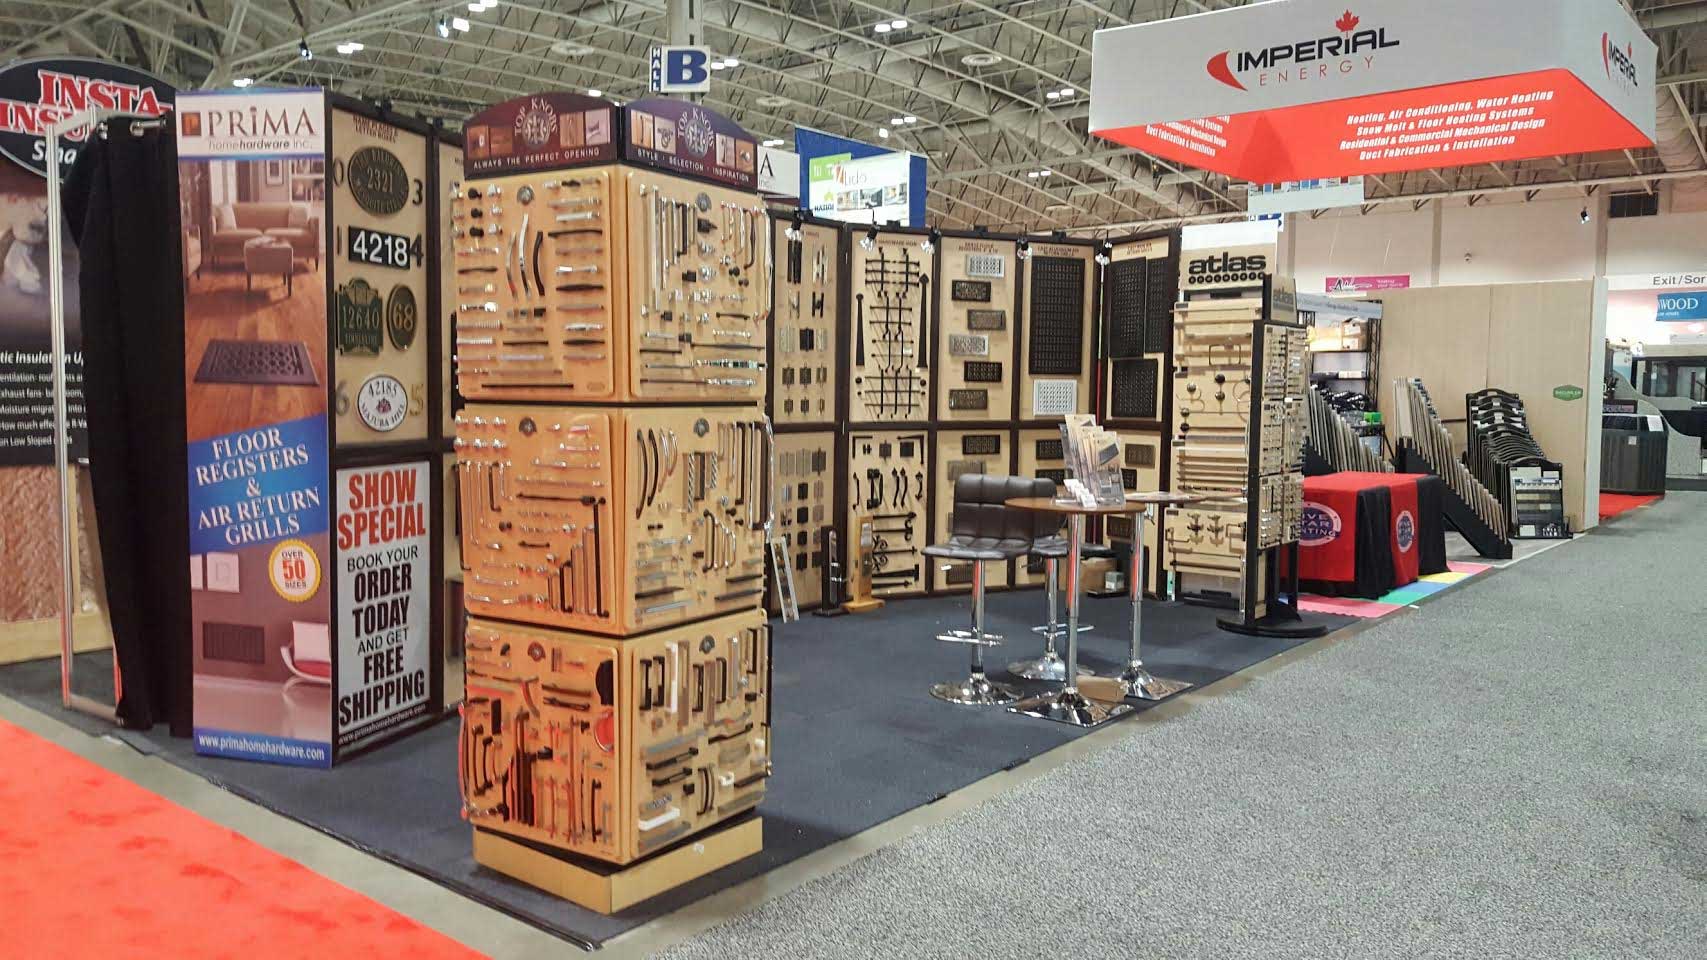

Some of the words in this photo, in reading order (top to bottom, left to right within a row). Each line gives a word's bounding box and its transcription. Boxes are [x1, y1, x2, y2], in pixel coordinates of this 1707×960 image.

[652, 47, 661, 92] HALL
[667, 50, 708, 84] B
[1260, 55, 1374, 87] ENERGY
[514, 106, 526, 137] TOP
[1347, 113, 1386, 125] Heating,
[1388, 109, 1403, 120] Air
[1405, 100, 1473, 119] Conditioning,
[1476, 96, 1508, 109] Water
[1511, 90, 1554, 104] Heating
[1356, 124, 1382, 137] Snow
[1384, 121, 1407, 133] Melt
[1408, 121, 1415, 130] &
[1417, 116, 1444, 129] Floor
[1446, 111, 1487, 126] Heating
[1488, 105, 1534, 121] Systems
[677, 111, 688, 139] TOP
[1339, 135, 1390, 151] Residential
[1390, 136, 1397, 145] &
[1398, 127, 1453, 144] Commercial
[1454, 121, 1510, 138] Mechanical
[1511, 117, 1546, 132] Design
[473, 158, 502, 170] ALWAYS
[507, 157, 520, 166] THE
[525, 152, 560, 165] PERFECT
[564, 147, 600, 160] OPENING
[1359, 148, 1382, 161] Duct
[1383, 141, 1441, 159] Fabrication
[1442, 142, 1450, 152] &
[1452, 134, 1516, 150] Installation
[637, 148, 658, 161] STYLE
[669, 155, 704, 171] SELECTION
[712, 167, 749, 183] INSPIRATION
[353, 230, 408, 267] 4218
[410, 233, 424, 267] 4
[1188, 252, 1266, 275] atlas
[393, 304, 414, 332] 68
[16, 350, 71, 364] Insulatn
[212, 427, 283, 460] FLOOR
[195, 443, 309, 486] REGISTERS
[245, 477, 262, 497] &
[348, 469, 417, 510] SHOW
[198, 504, 233, 530] AIR
[236, 486, 321, 521] RETURN
[225, 513, 300, 545] GRILLS
[337, 502, 426, 551] SPECIAL
[281, 550, 305, 560] OVER
[282, 559, 306, 581] 50
[347, 554, 383, 573] BOOK
[386, 544, 418, 565] YOUR
[285, 581, 307, 590] SIZES
[354, 562, 412, 604] ORDER
[352, 595, 410, 638] TODAY
[357, 635, 383, 656] AND
[386, 627, 409, 646] GET
[363, 645, 404, 685] FREE
[338, 668, 425, 727] SHIPPING
[198, 735, 325, 761] www.primahomehardware.com
